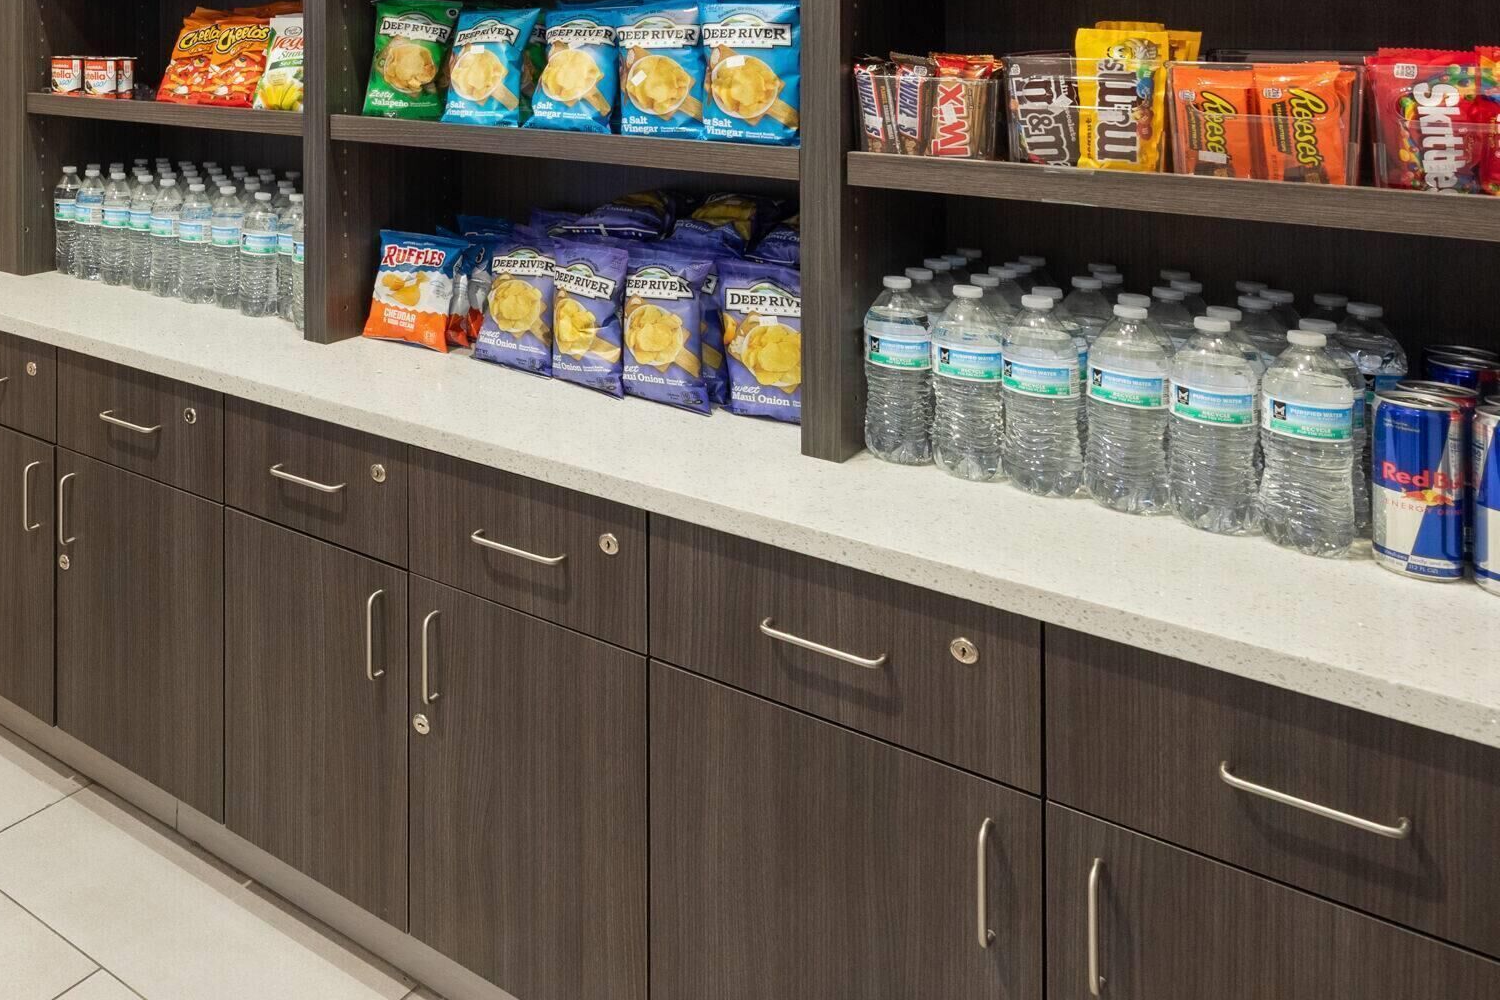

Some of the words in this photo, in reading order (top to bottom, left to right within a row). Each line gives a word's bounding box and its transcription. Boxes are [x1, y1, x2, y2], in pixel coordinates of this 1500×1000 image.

[382, 19, 411, 31] DEEP
[411, 23, 449, 37] RIVER
[457, 30, 480, 42] DEEP
[480, 25, 515, 40] RIVER
[547, 29, 574, 39] DEEP
[576, 28, 613, 40] RIVER
[618, 28, 650, 40] DEEP
[652, 28, 696, 41] RIVER
[703, 28, 734, 39] DEEP
[739, 28, 787, 40] RIVER
[216, 23, 270, 54] Cheetos
[629, 116, 648, 124] Salt
[712, 118, 732, 128] Salt
[1288, 88, 1326, 167] Reese's
[383, 246, 445, 267] RUFFLES
[493, 259, 518, 268] DEEP
[519, 260, 555, 272] RIVER
[555, 272, 573, 284] DEEP
[574, 278, 609, 294] RIVER
[627, 280, 648, 288] EEP
[648, 281, 689, 292] RIVER
[730, 293, 767, 305] DEEP
[384, 309, 416, 322] CHEDDAR
[496, 339, 517, 350] Onion
[637, 373, 665, 384] Onion
[732, 391, 756, 402] Maui
[758, 394, 791, 406] Onion
[1381, 462, 1430, 487] Red
